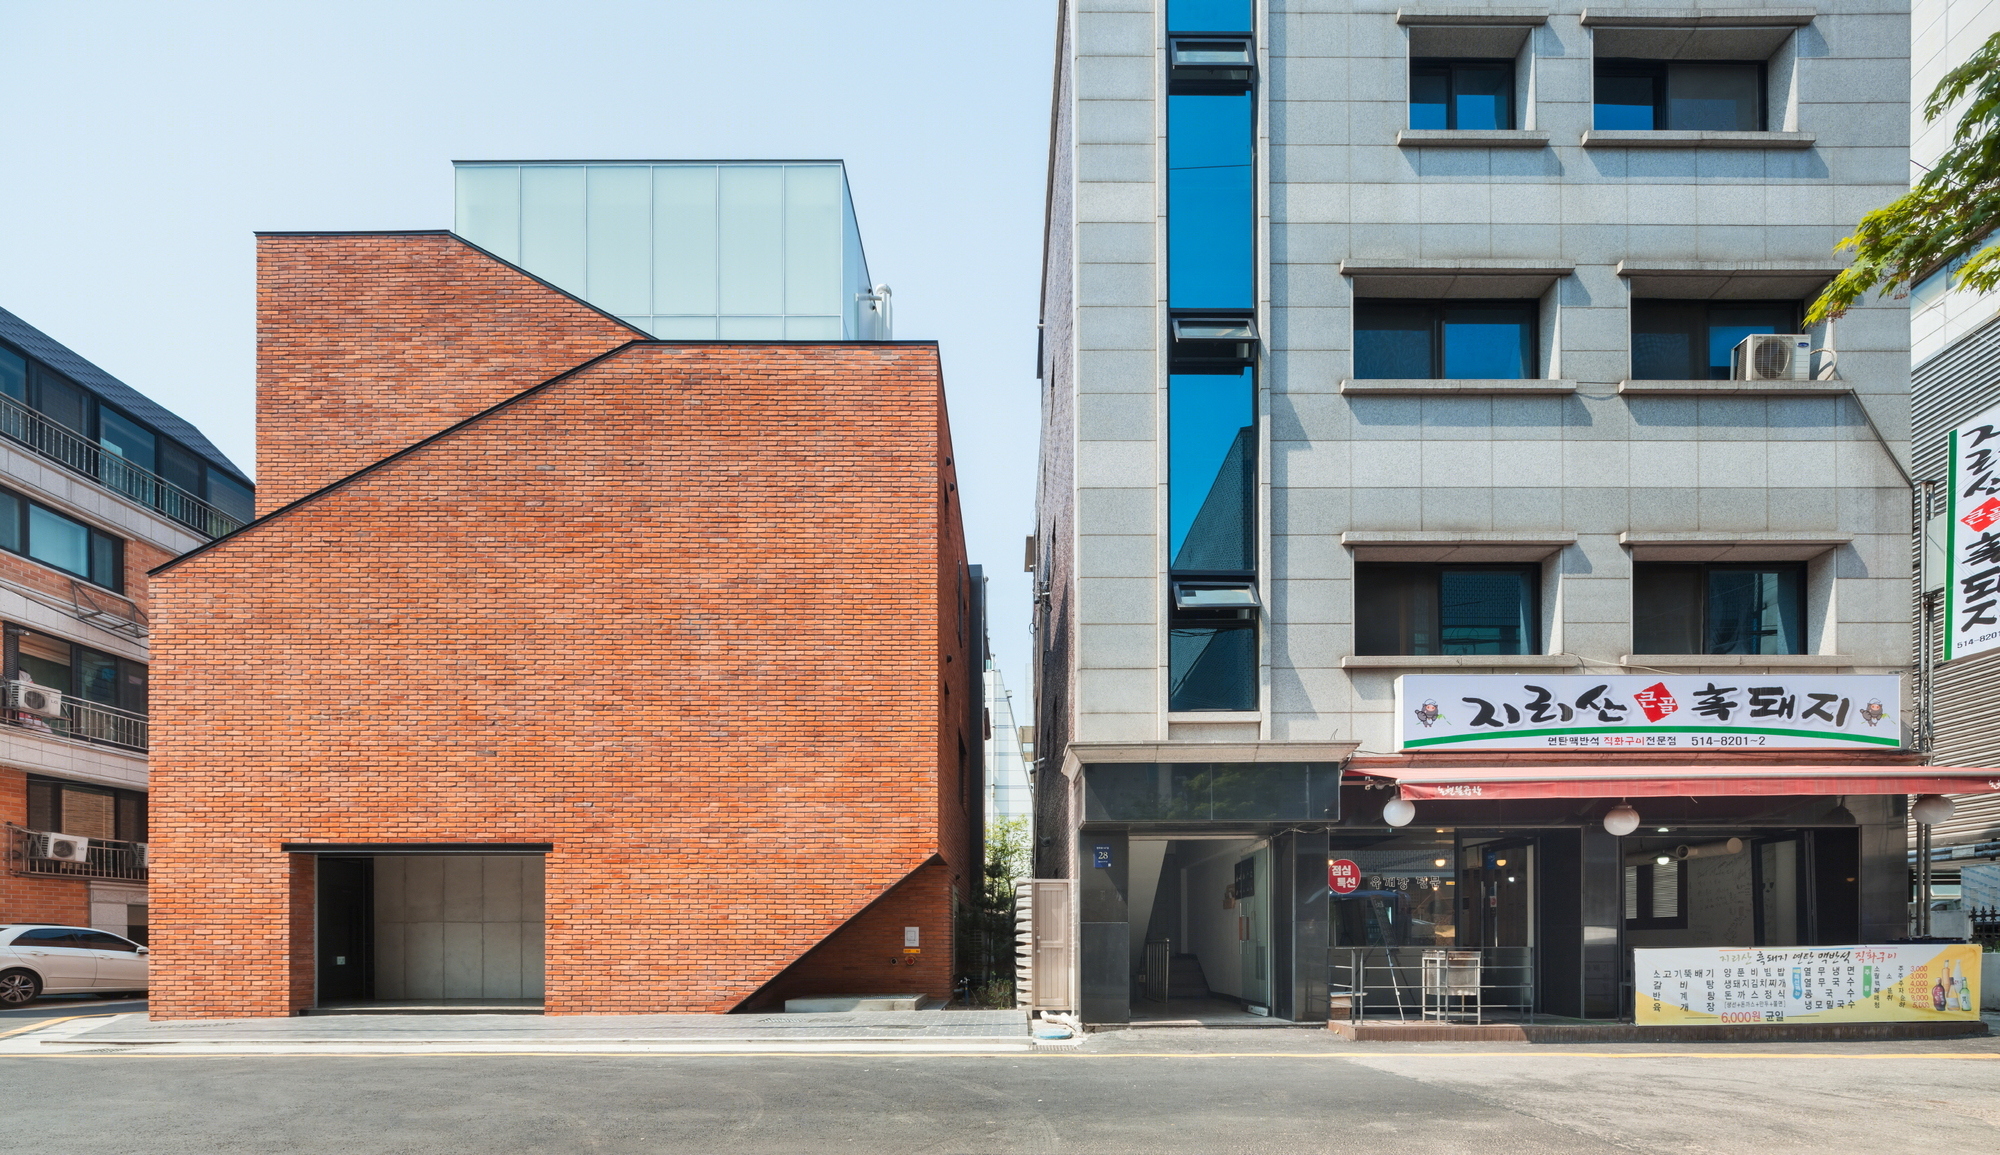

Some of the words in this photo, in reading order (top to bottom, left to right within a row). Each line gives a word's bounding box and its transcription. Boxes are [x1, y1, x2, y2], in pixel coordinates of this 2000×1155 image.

[1462, 684, 1628, 727] 지리산
[1637, 690, 1678, 715] 큰골
[1691, 682, 1851, 727] 흑돼지
[1691, 736, 1766, 747] 514-8201~2
[1098, 851, 1109, 860] 28
[1331, 865, 1352, 876] 점심
[1337, 877, 1357, 888] 특선
[1370, 876, 1410, 890] 육개장
[1719, 952, 1753, 966] 지리산
[1756, 951, 1788, 966] 흑돼지
[1792, 951, 1815, 965] 연탄
[1818, 951, 1851, 965] 맥반석
[1854, 949, 1898, 964] 직화구이
[1653, 968, 1715, 979] 소고기뚝배기
[1723, 967, 1786, 978] 양푼비빔밥
[1803, 966, 1855, 976] 열무냉면
[1653, 980, 1715, 990] 갈비탕
[1723, 979, 1787, 989] 생돼지김치찌개
[1803, 978, 1855, 988] 열무국수
[1724, 990, 1786, 1000] 돈까스정식
[1653, 1003, 1716, 1013] 육개장
[1721, 1010, 1761, 1024] 6,000원
[1764, 1010, 1785, 1022] 균일
